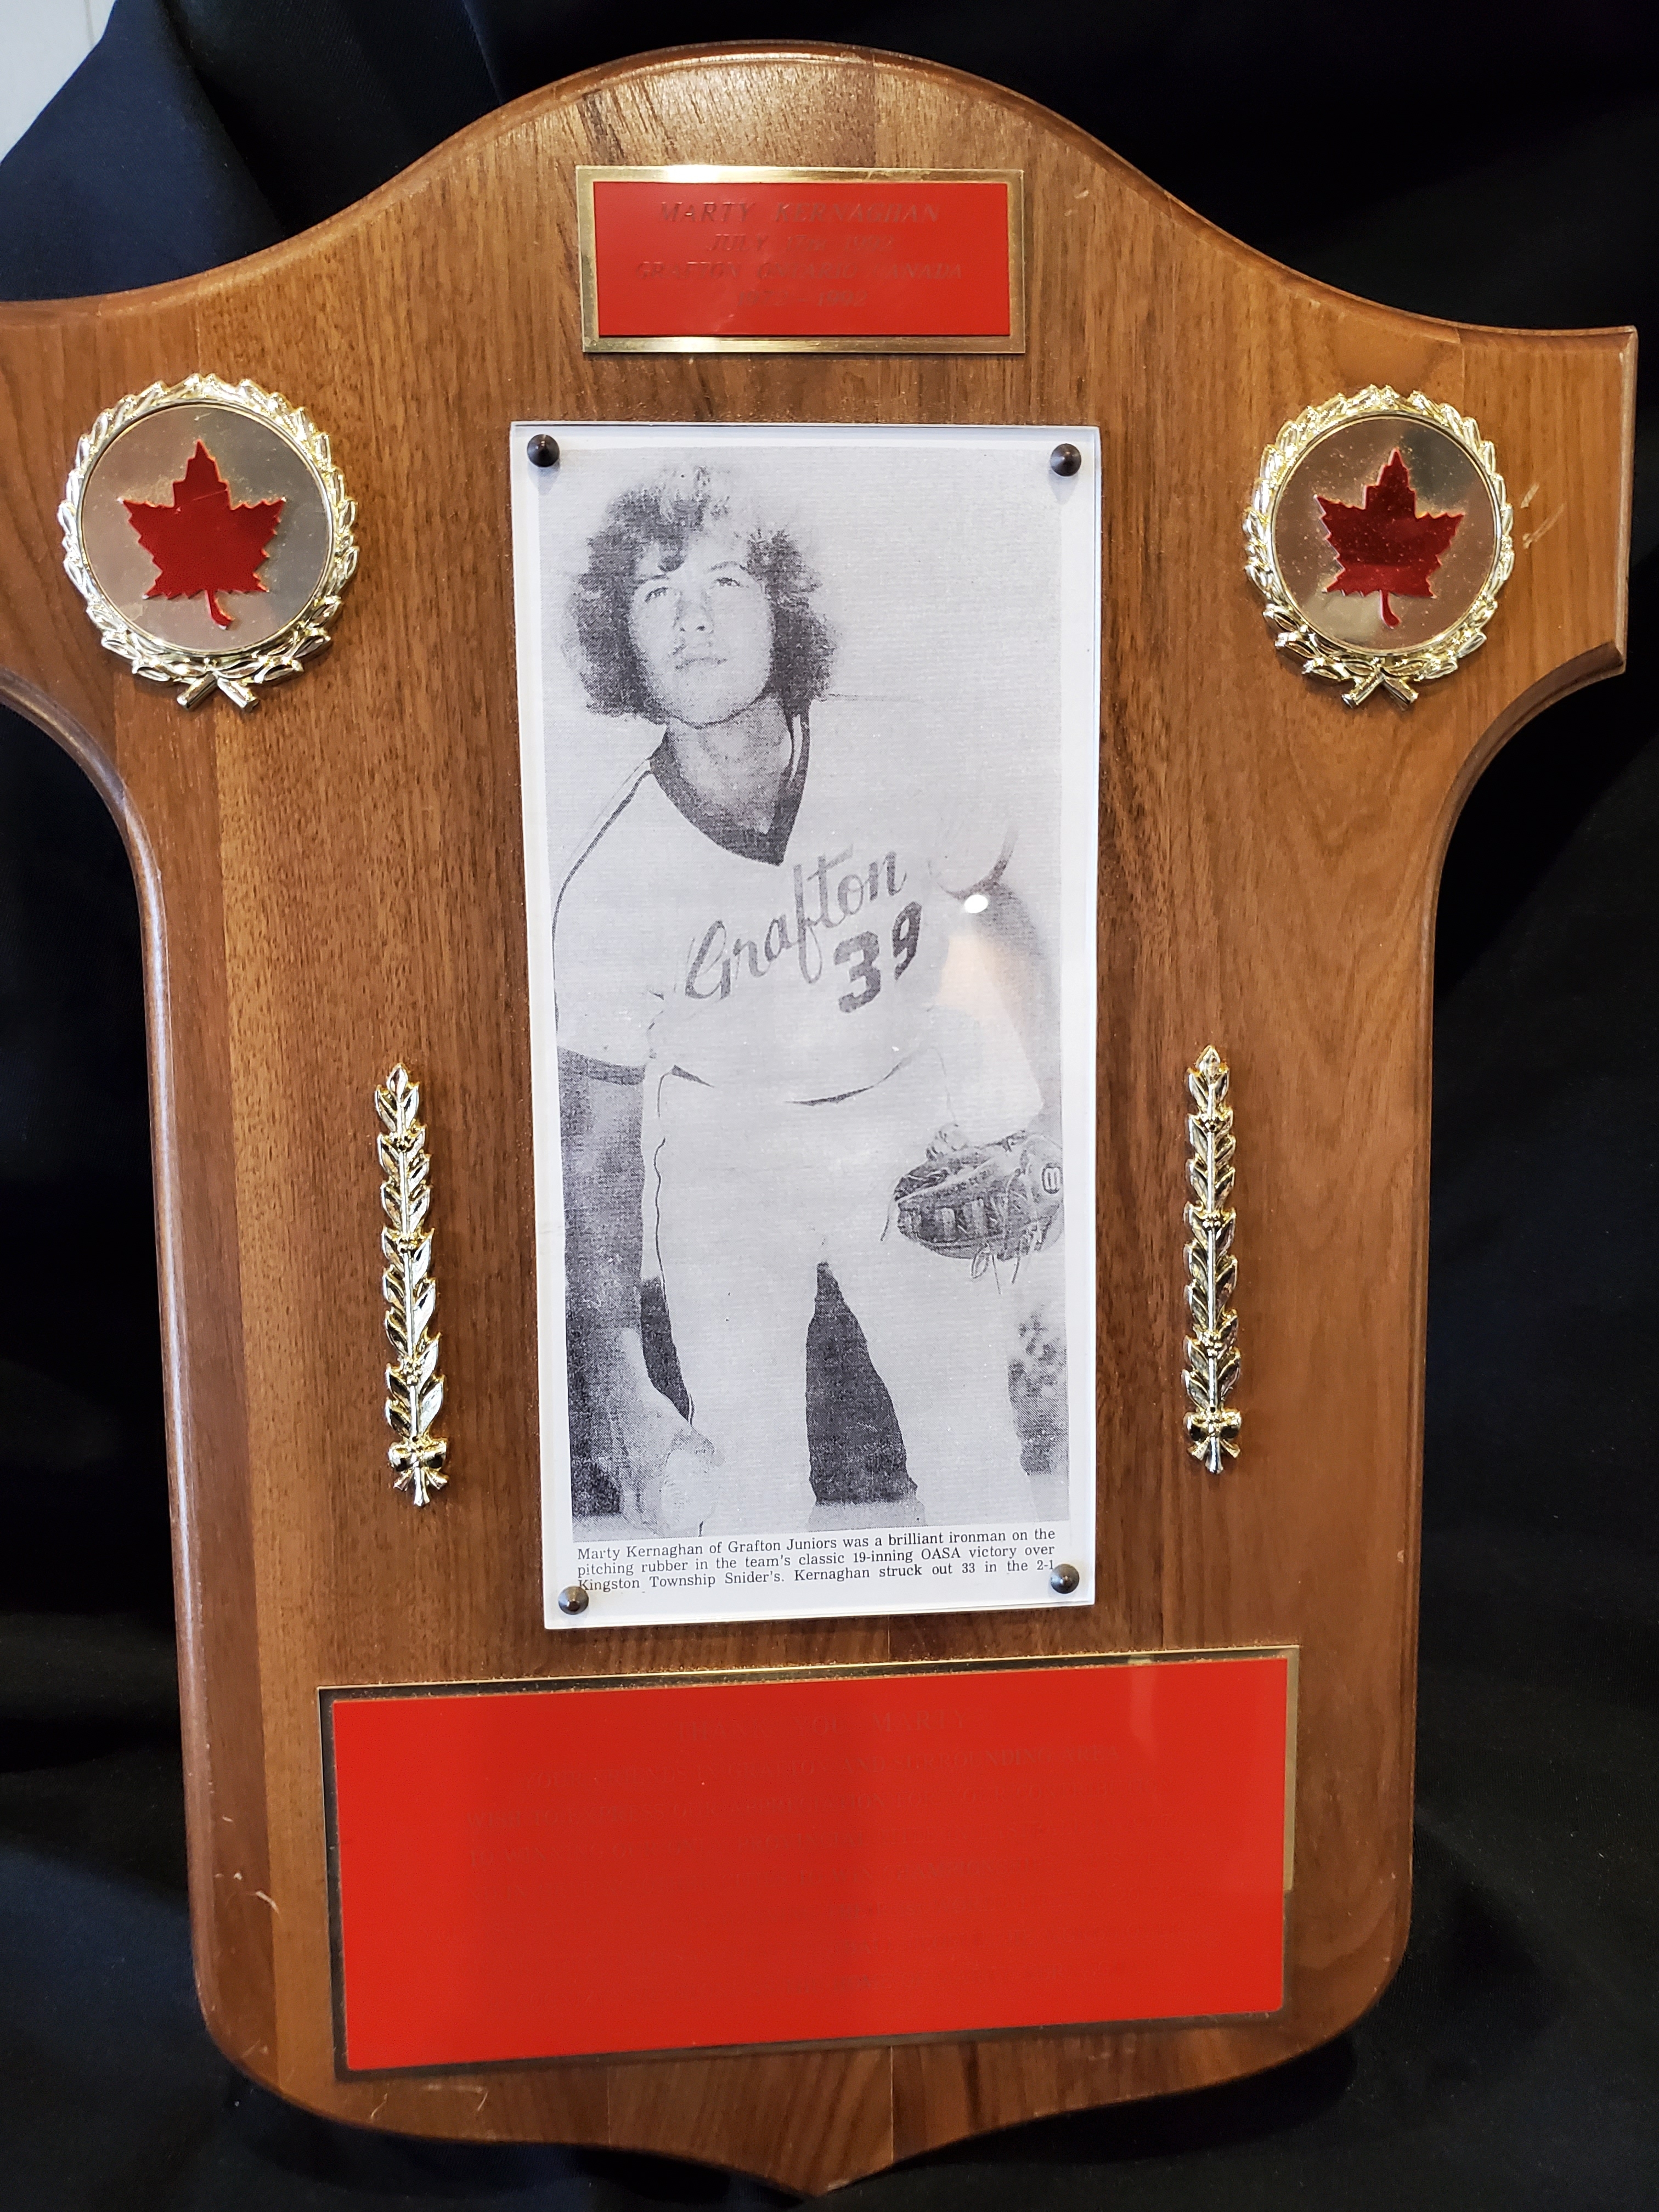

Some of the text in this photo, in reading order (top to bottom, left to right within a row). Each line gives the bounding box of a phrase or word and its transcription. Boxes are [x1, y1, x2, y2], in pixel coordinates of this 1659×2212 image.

[659, 201, 940, 223] MARTY KERNAGHAN
[685, 844, 907, 1000] Grafton
[833, 901, 923, 1013] 39
[578, 1528, 1056, 1561] Marty Kernaghan of Grafton Juniors was a brilliant ironman on the
[578, 1545, 1055, 1578] pitching rubber in the team's classic 19-inning OASA victory over
[578, 1577, 640, 1592] Kingston
[649, 1573, 715, 1588] Township
[725, 1570, 785, 1585] Snider's.
[794, 1566, 870, 1582] Kernaghan
[879, 1564, 922, 1577] struck
[932, 1564, 953, 1576] out
[962, 1562, 975, 1573] 33
[985, 1561, 997, 1572] in
[1007, 1560, 1029, 1571] the
